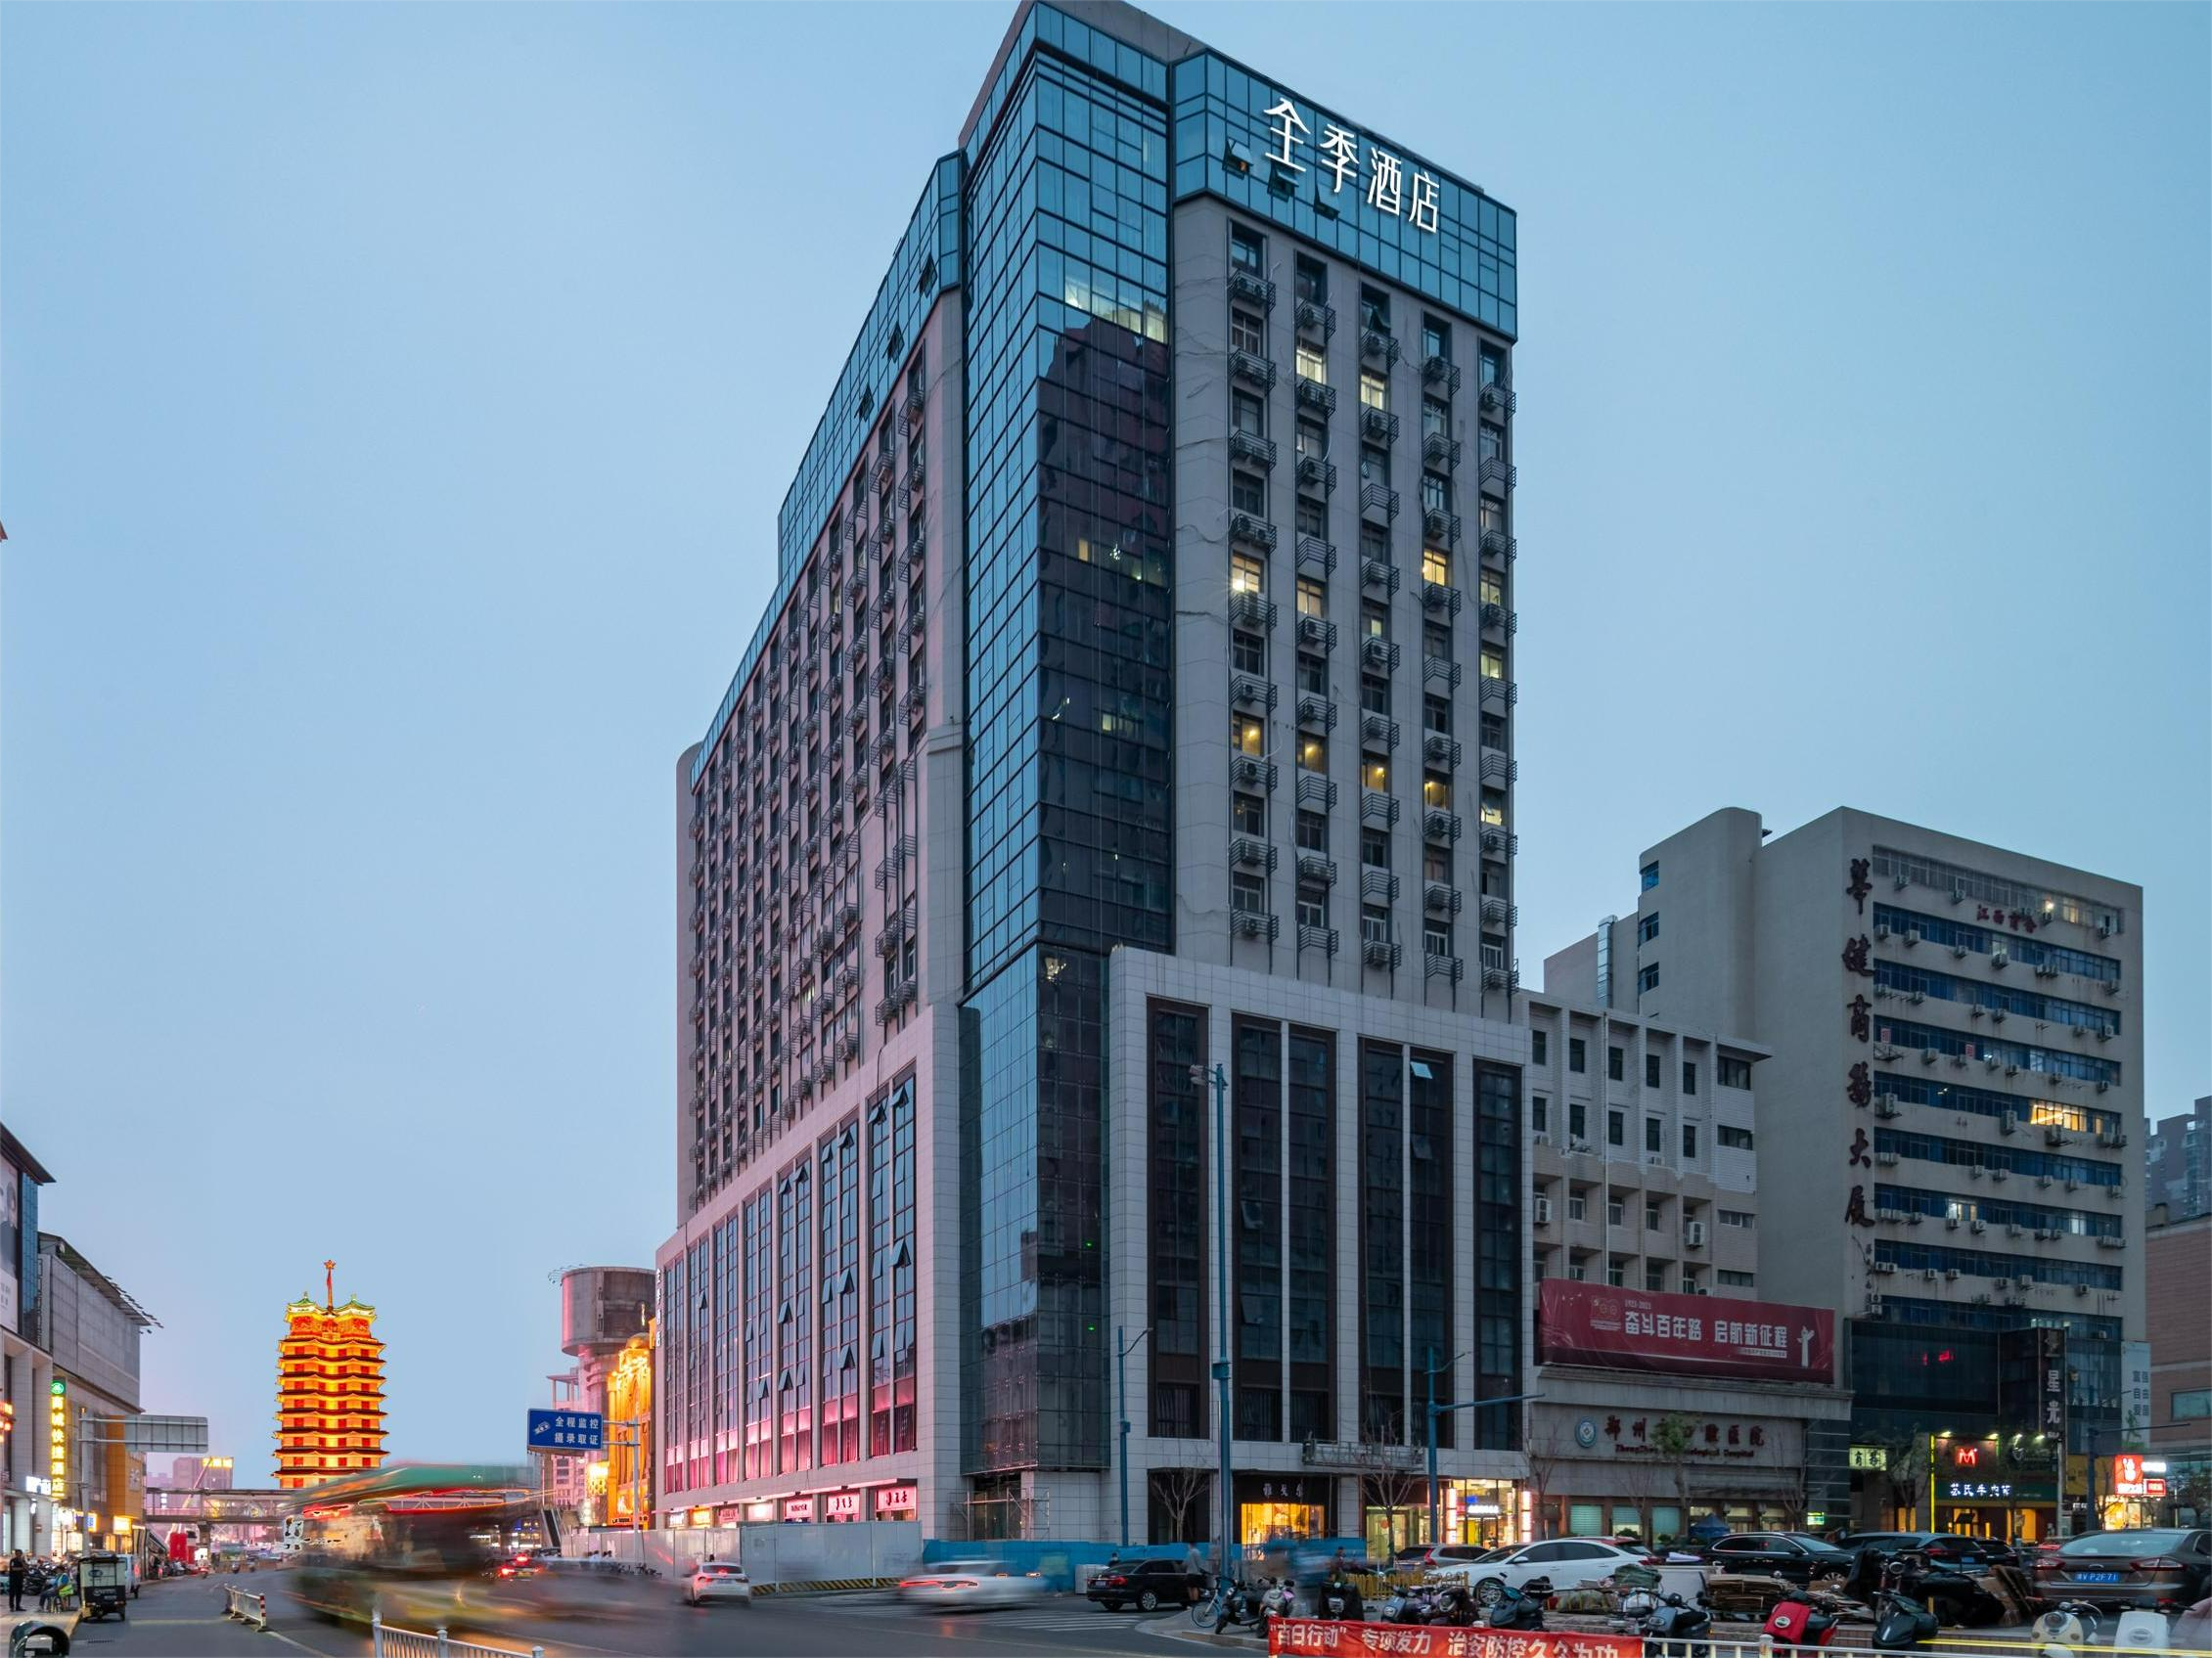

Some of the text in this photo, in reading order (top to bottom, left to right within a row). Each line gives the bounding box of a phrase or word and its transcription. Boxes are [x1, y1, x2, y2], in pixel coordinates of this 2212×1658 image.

[1263, 97, 1440, 235] 全季酒店
[1625, 1311, 1788, 1348] 奋斗百年路 启航新征程
[555, 1415, 599, 1429] 全程监控
[554, 1431, 599, 1446] 摄录取证
[1361, 1628, 1431, 1655] 专项发力
